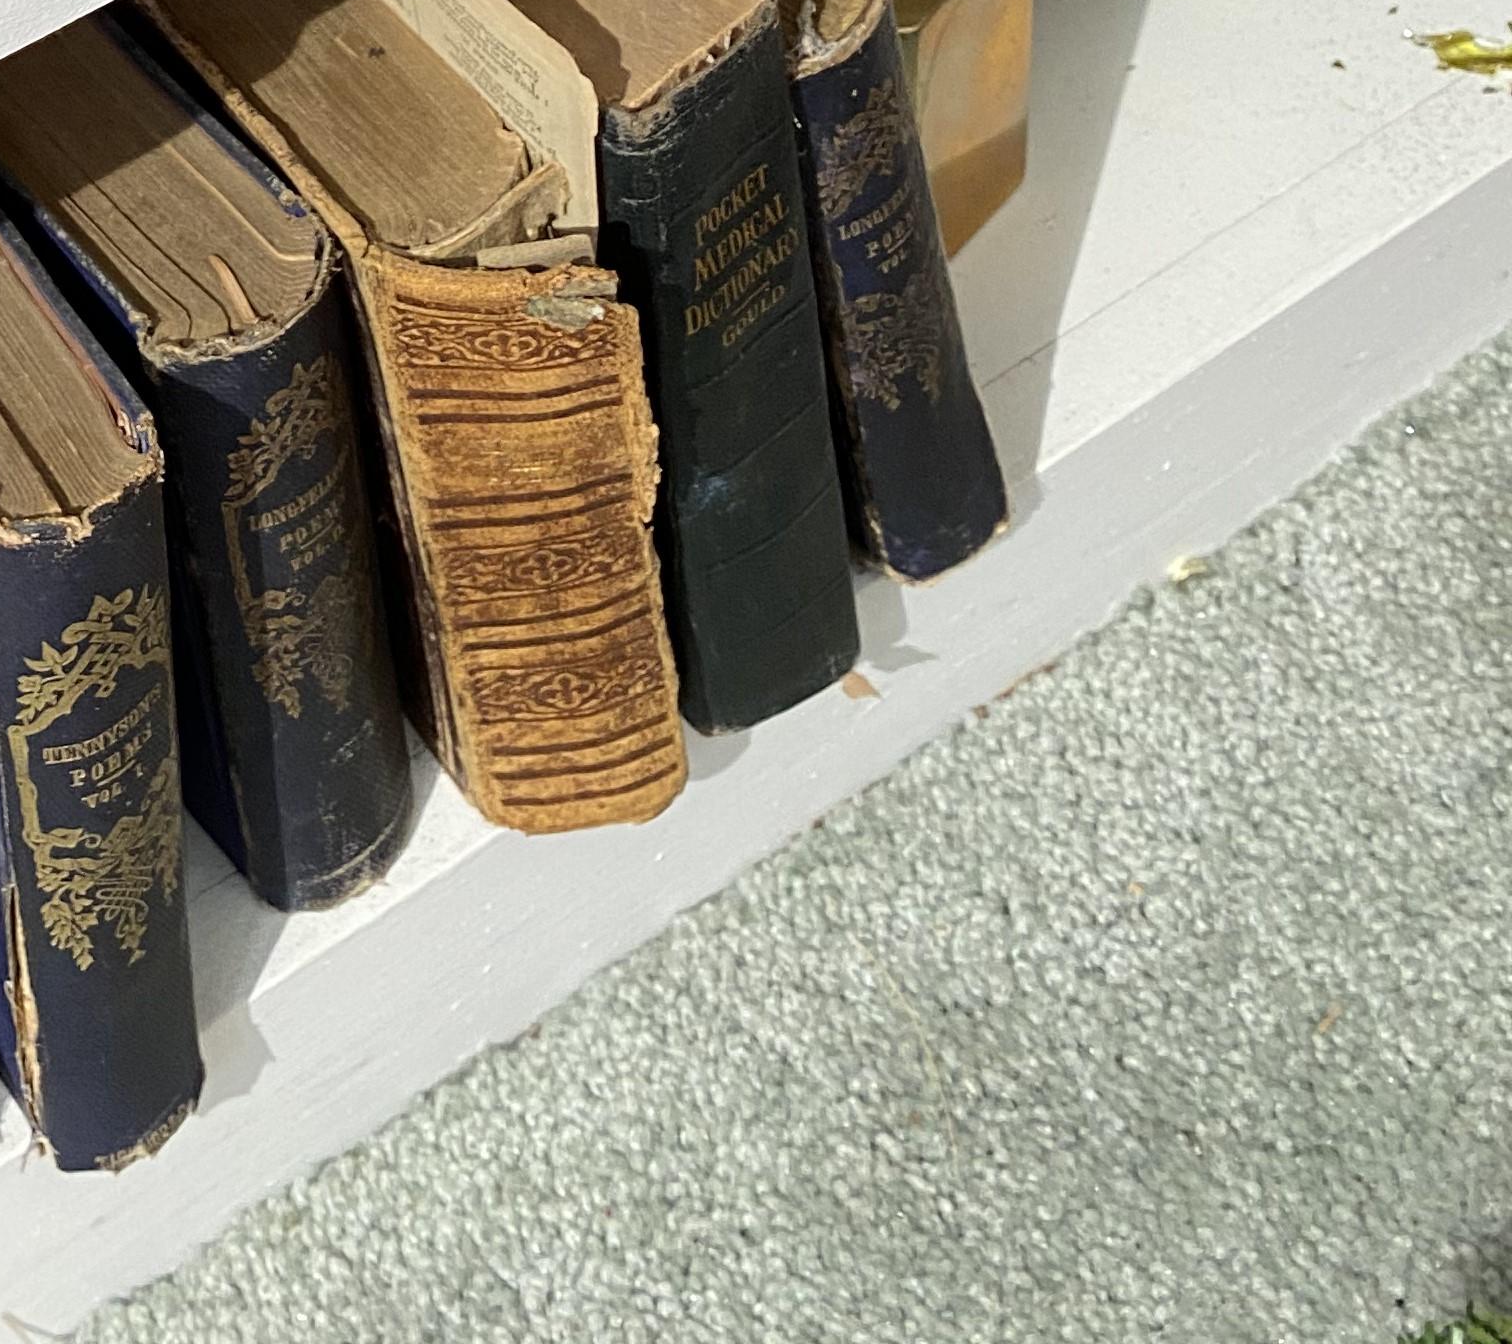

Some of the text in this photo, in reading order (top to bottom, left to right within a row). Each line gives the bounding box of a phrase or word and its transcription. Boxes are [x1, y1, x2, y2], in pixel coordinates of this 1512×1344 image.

[693, 192, 790, 293] MEDICAL
[694, 163, 769, 248] POCKET
[684, 227, 800, 336] DICTIONARY
[722, 283, 786, 348] GOULD
